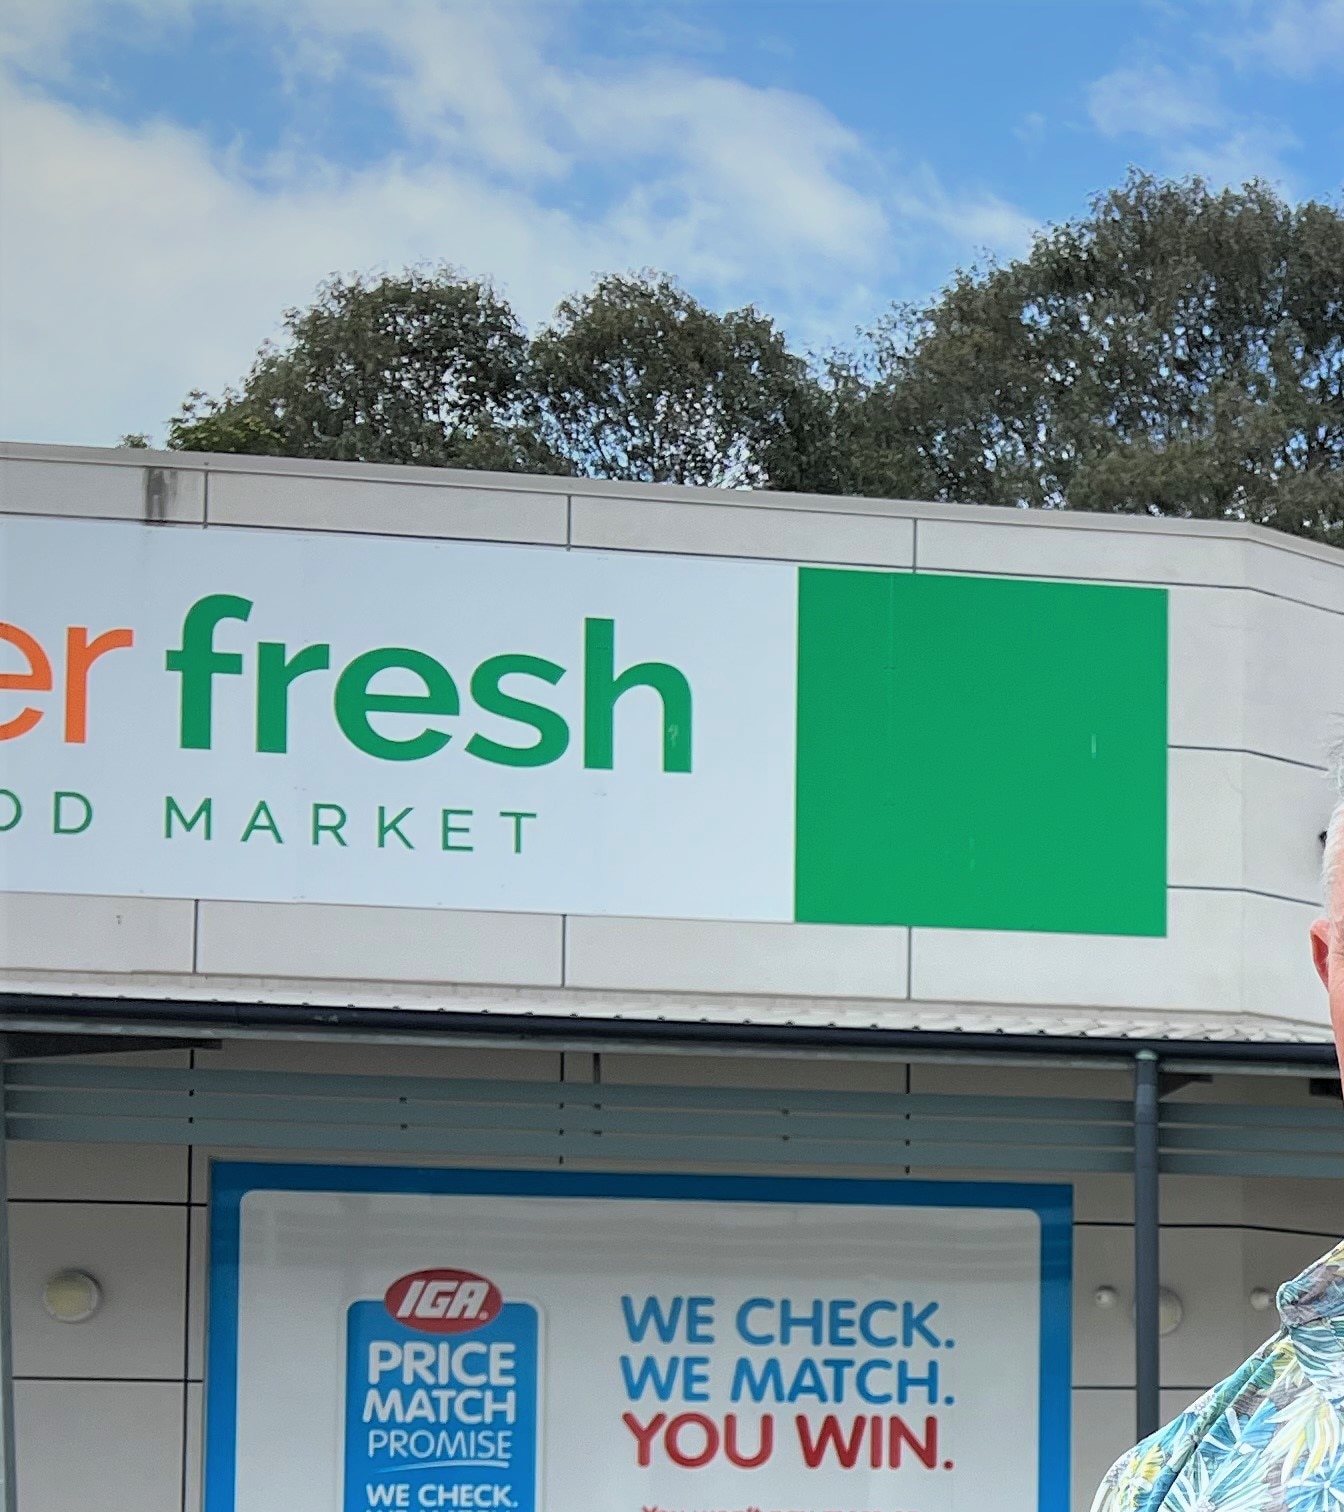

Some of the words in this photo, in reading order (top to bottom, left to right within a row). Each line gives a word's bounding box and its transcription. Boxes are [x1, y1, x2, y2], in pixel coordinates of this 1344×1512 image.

[165, 594, 693, 774] fresh
[164, 796, 538, 855] MARKET
[620, 1295, 715, 1344] WE
[735, 1297, 955, 1349] CHECK.
[368, 1342, 516, 1386] PRICE
[619, 1355, 711, 1402] WE
[730, 1357, 955, 1406] MATCH.
[363, 1390, 516, 1424] MATCH
[368, 1430, 512, 1460] PROMISE
[622, 1412, 773, 1468] YOU
[795, 1414, 954, 1470] WIN.
[366, 1484, 410, 1507] WE
[417, 1484, 518, 1508] CHECK.
